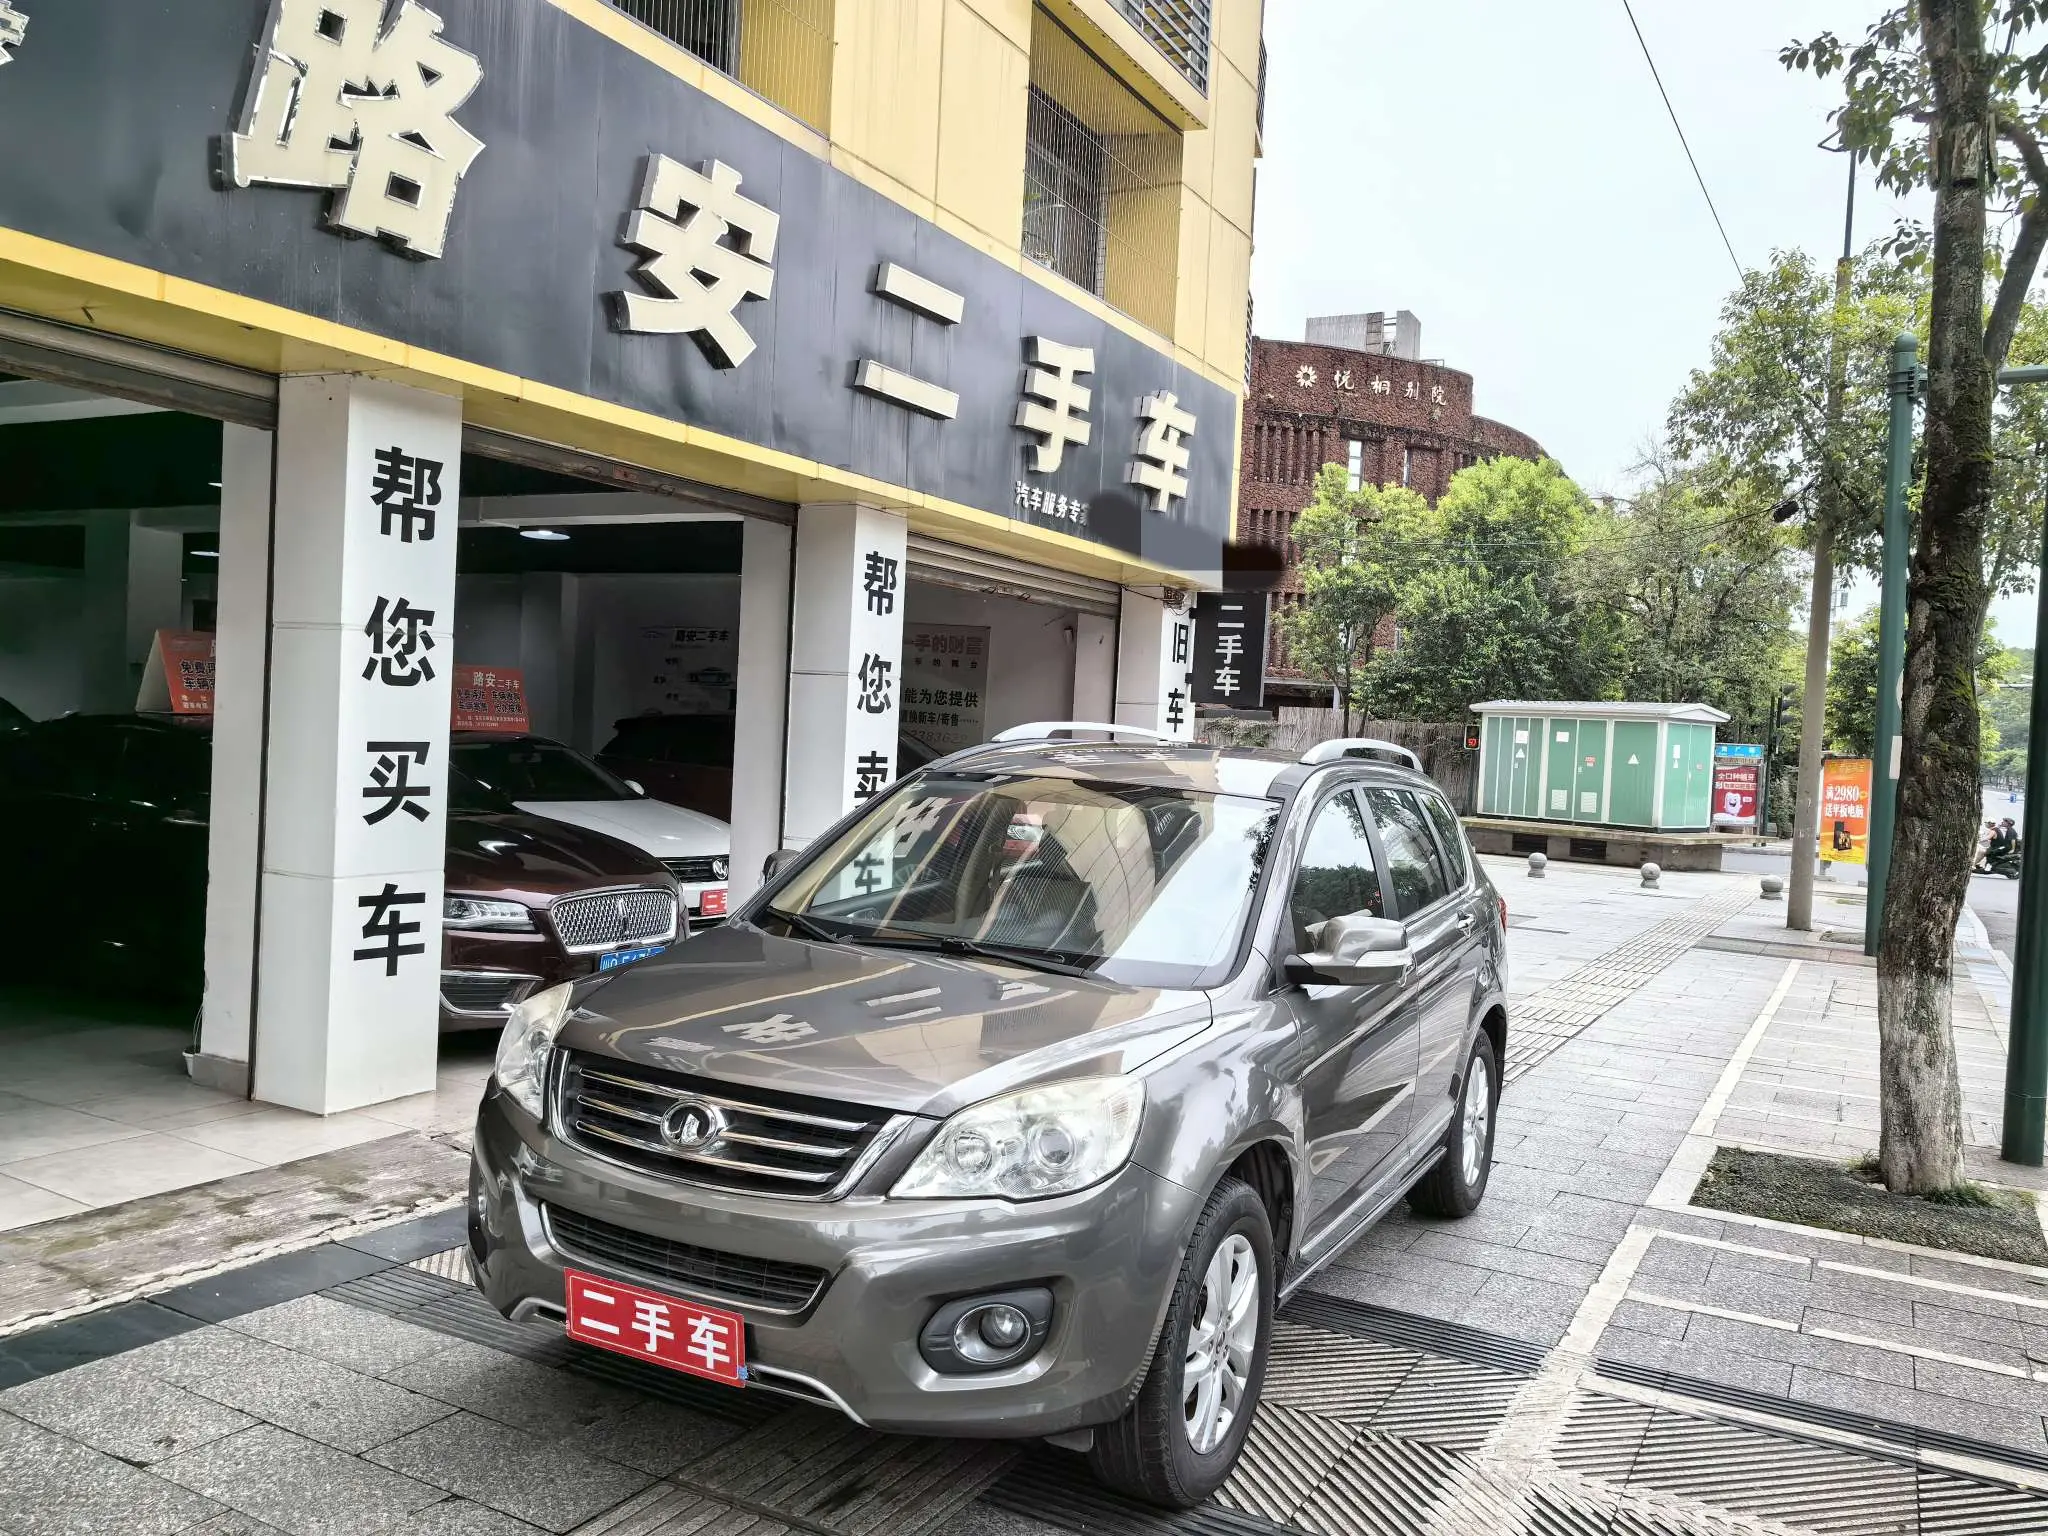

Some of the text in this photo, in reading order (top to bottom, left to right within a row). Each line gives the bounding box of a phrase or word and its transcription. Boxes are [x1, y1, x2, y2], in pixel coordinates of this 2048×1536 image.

[0, 0, 1196, 514] 路安二手车
[1334, 369, 1446, 406] 悦桐别院
[1214, 605, 1245, 697] 二手车
[354, 446, 444, 976] 帮您买车
[580, 1288, 731, 1370] 二手车
